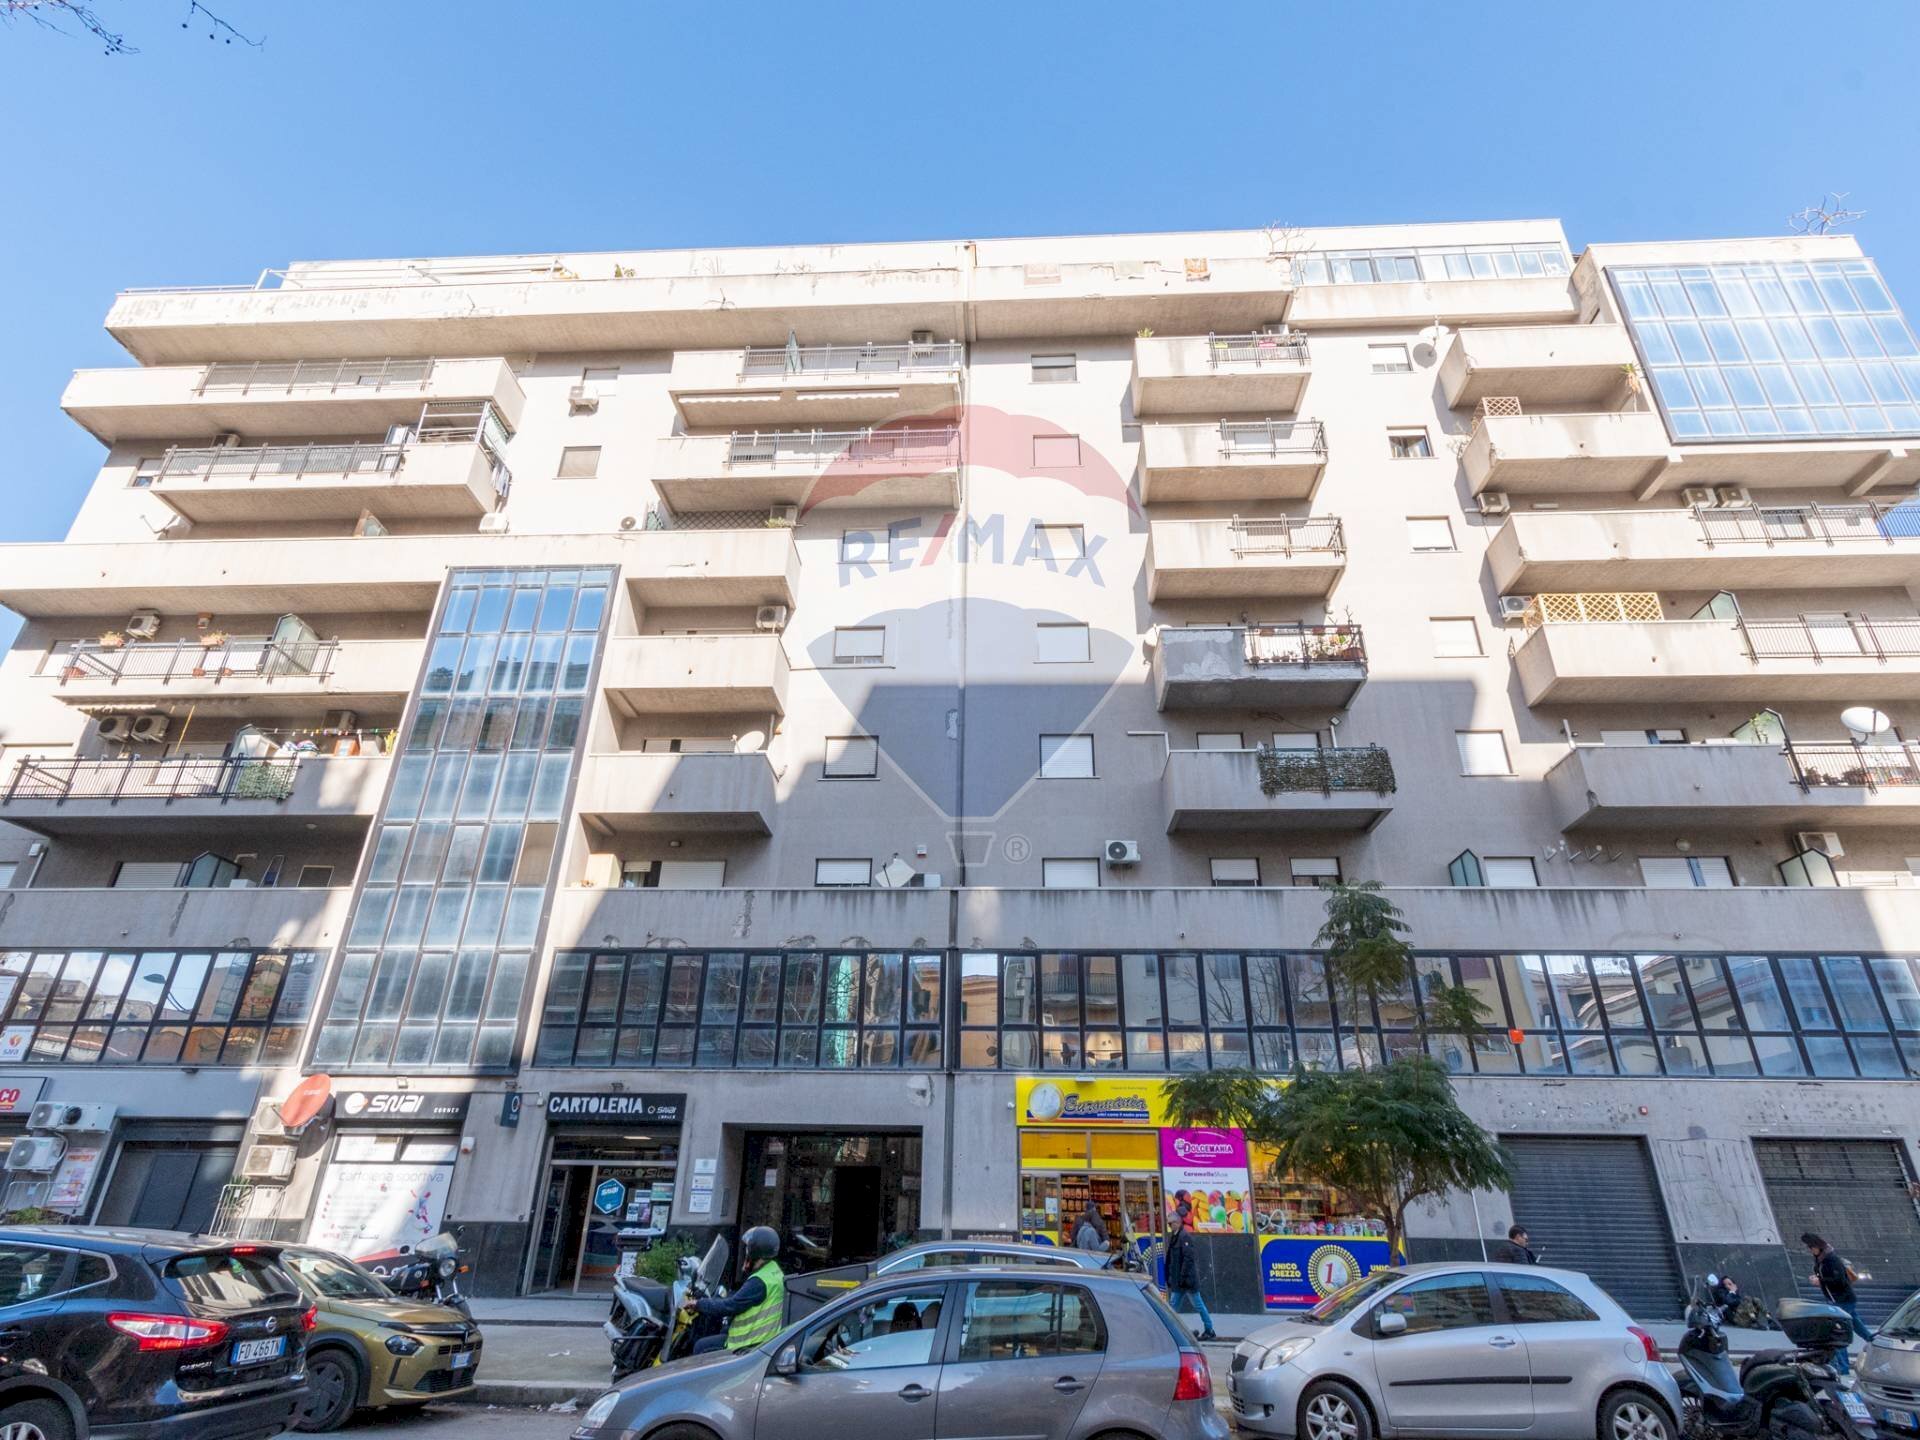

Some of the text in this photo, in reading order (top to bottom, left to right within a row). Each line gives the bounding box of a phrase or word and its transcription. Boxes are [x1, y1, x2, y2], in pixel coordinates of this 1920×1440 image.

[549, 1096, 643, 1114] CARTOLERIA
[1064, 1093, 1147, 1113] Euromania
[1184, 1142, 1233, 1154] DOLCEMANIA
[1269, 1270, 1302, 1278] PREZZO
